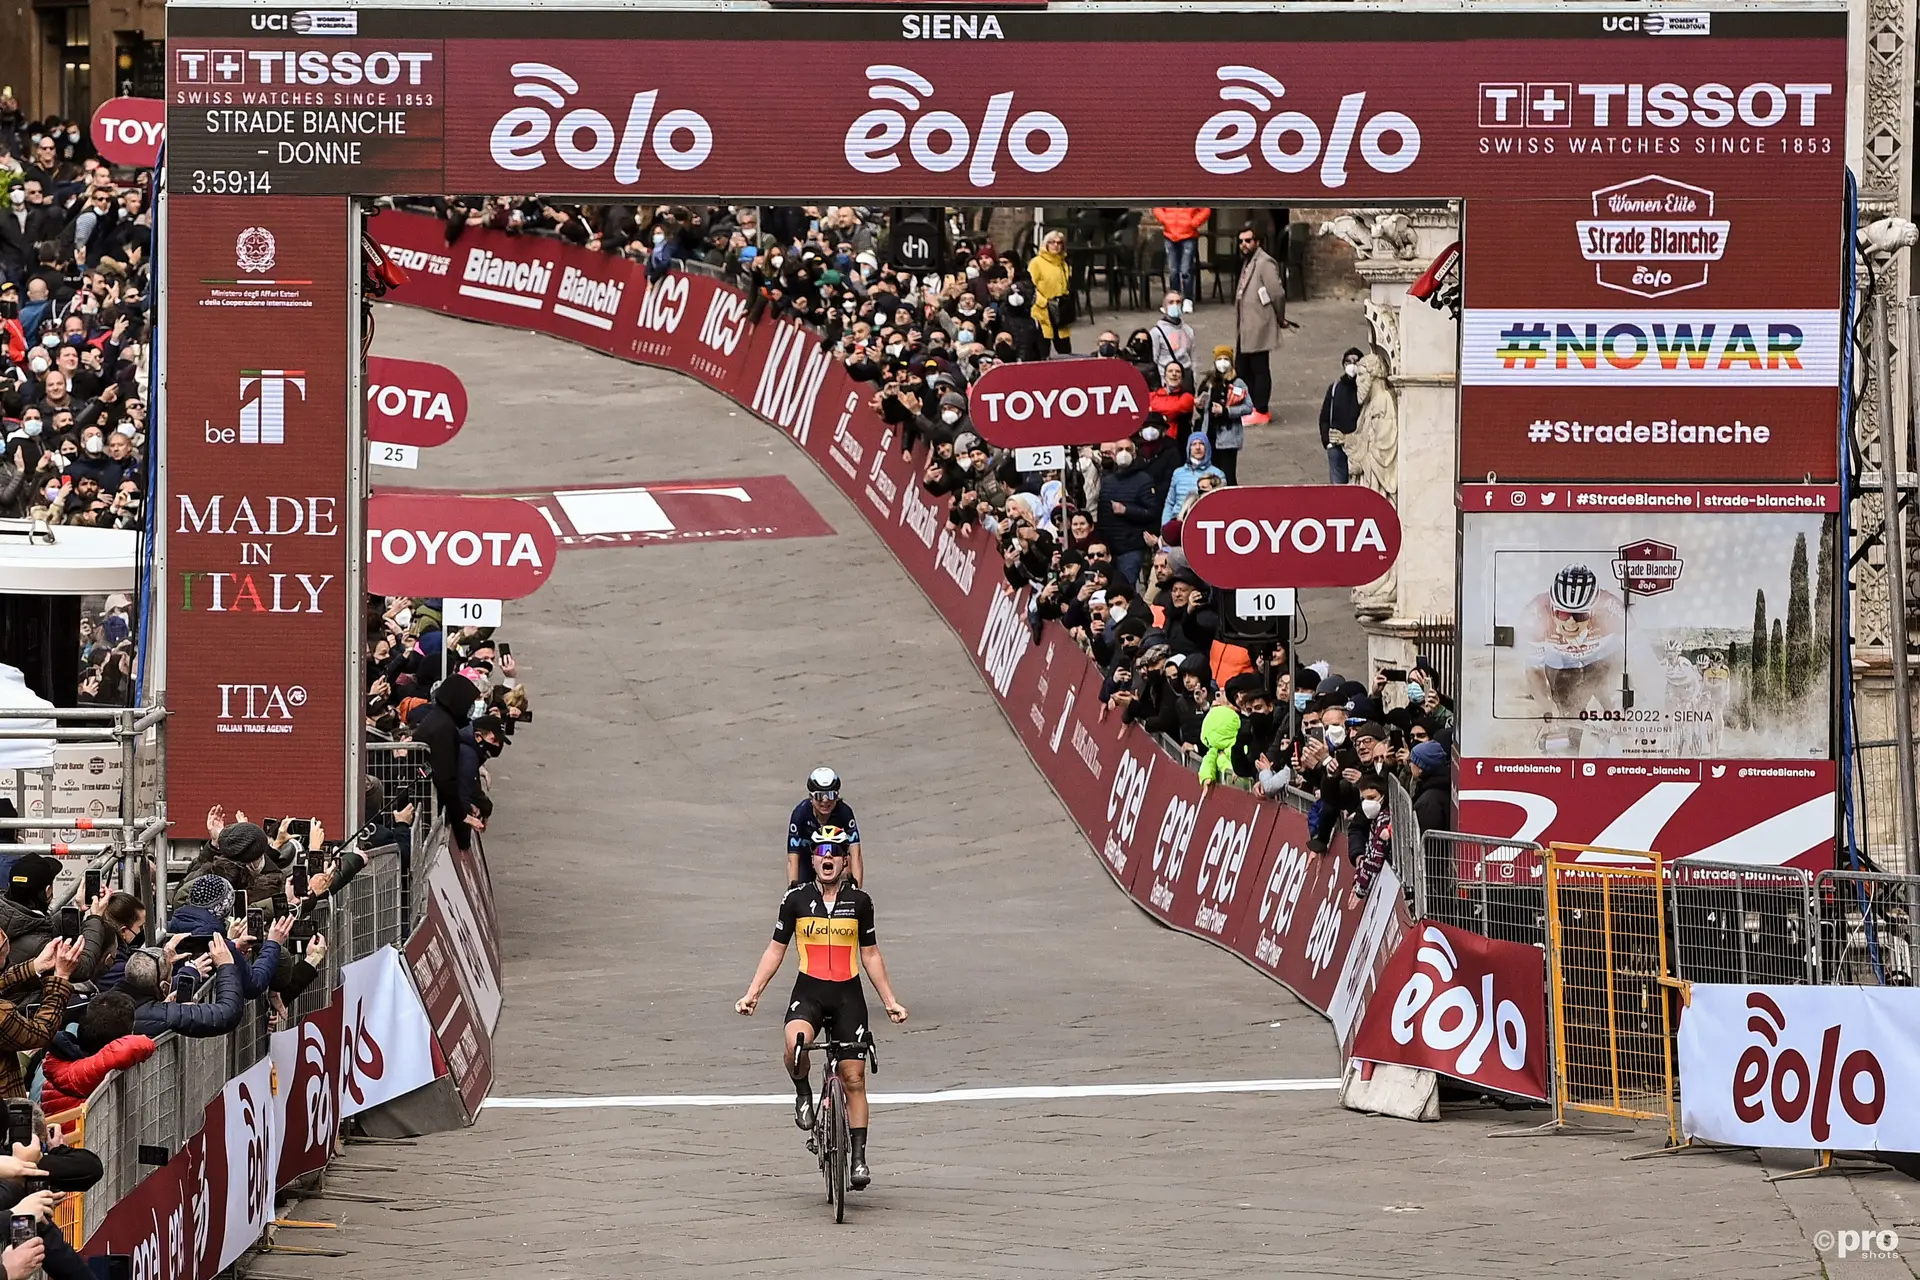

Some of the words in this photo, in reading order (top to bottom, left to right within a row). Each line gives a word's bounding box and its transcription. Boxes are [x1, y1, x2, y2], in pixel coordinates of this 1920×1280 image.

[251, 14, 288, 30] UCI
[902, 14, 1004, 39] SIENA
[1602, 16, 1640, 31] UCI
[249, 51, 433, 85] TISSOT
[177, 91, 233, 105] SWISS
[243, 92, 324, 106] WATCHES
[334, 93, 387, 106] SINCE
[396, 93, 434, 107] 1853
[1578, 82, 1832, 128] TISSOT
[100, 117, 166, 146] TOY
[206, 111, 295, 134] STRADE
[303, 112, 406, 135] BIANCHE
[489, 89, 713, 185] eolo
[844, 91, 1069, 187] eolo
[1195, 91, 1421, 188] eolo
[1479, 137, 1555, 154] SWISS
[1569, 137, 1681, 154] WATCHES
[1695, 137, 1766, 154] SINCE
[1780, 137, 1832, 154] 1853
[278, 142, 361, 165] DONNE
[192, 171, 272, 194] 3:59:14
[1608, 193, 1663, 214] Women
[1664, 193, 1697, 214] Elite
[1587, 226, 1645, 255] Strade
[1650, 226, 1720, 255] Bianche
[463, 247, 554, 295] Bianchi
[1632, 268, 1672, 288] eolo
[557, 265, 625, 315] Bianchi
[1496, 322, 1804, 370] #NOWAR
[981, 385, 1139, 423] TOYOTA
[205, 420, 236, 444] be
[1527, 418, 1770, 445] #StradeBianche
[384, 447, 404, 462] 25
[1031, 451, 1053, 467] 25
[1576, 492, 1692, 507] #StradeBianche
[1703, 494, 1826, 508] strade-bianche.it
[175, 494, 338, 536] MADE
[366, 529, 543, 567] TOYOTA
[1196, 517, 1387, 555] TOYOTA
[239, 542, 272, 565] IN
[1646, 563, 1677, 576] Bianche
[179, 572, 335, 614] ITALY
[1251, 594, 1276, 611] 10
[459, 602, 483, 620] 10
[216, 684, 294, 719] ITA
[216, 724, 243, 733] ITALIAN
[244, 724, 266, 733] TRADE
[266, 724, 294, 733] AGENCY
[1579, 710, 1660, 722] 05.03.2022
[1674, 710, 1714, 722] SIENA
[1494, 763, 1562, 775] stradebianche
[1607, 766, 1691, 777] @strade_bianche
[1738, 767, 1816, 779] @StradeBianche
[1107, 748, 1157, 848] enel
[1152, 793, 1206, 884] enel
[1196, 803, 1261, 905] enel
[1391, 972, 1527, 1075] eolo
[1732, 1024, 1886, 1143] eolo
